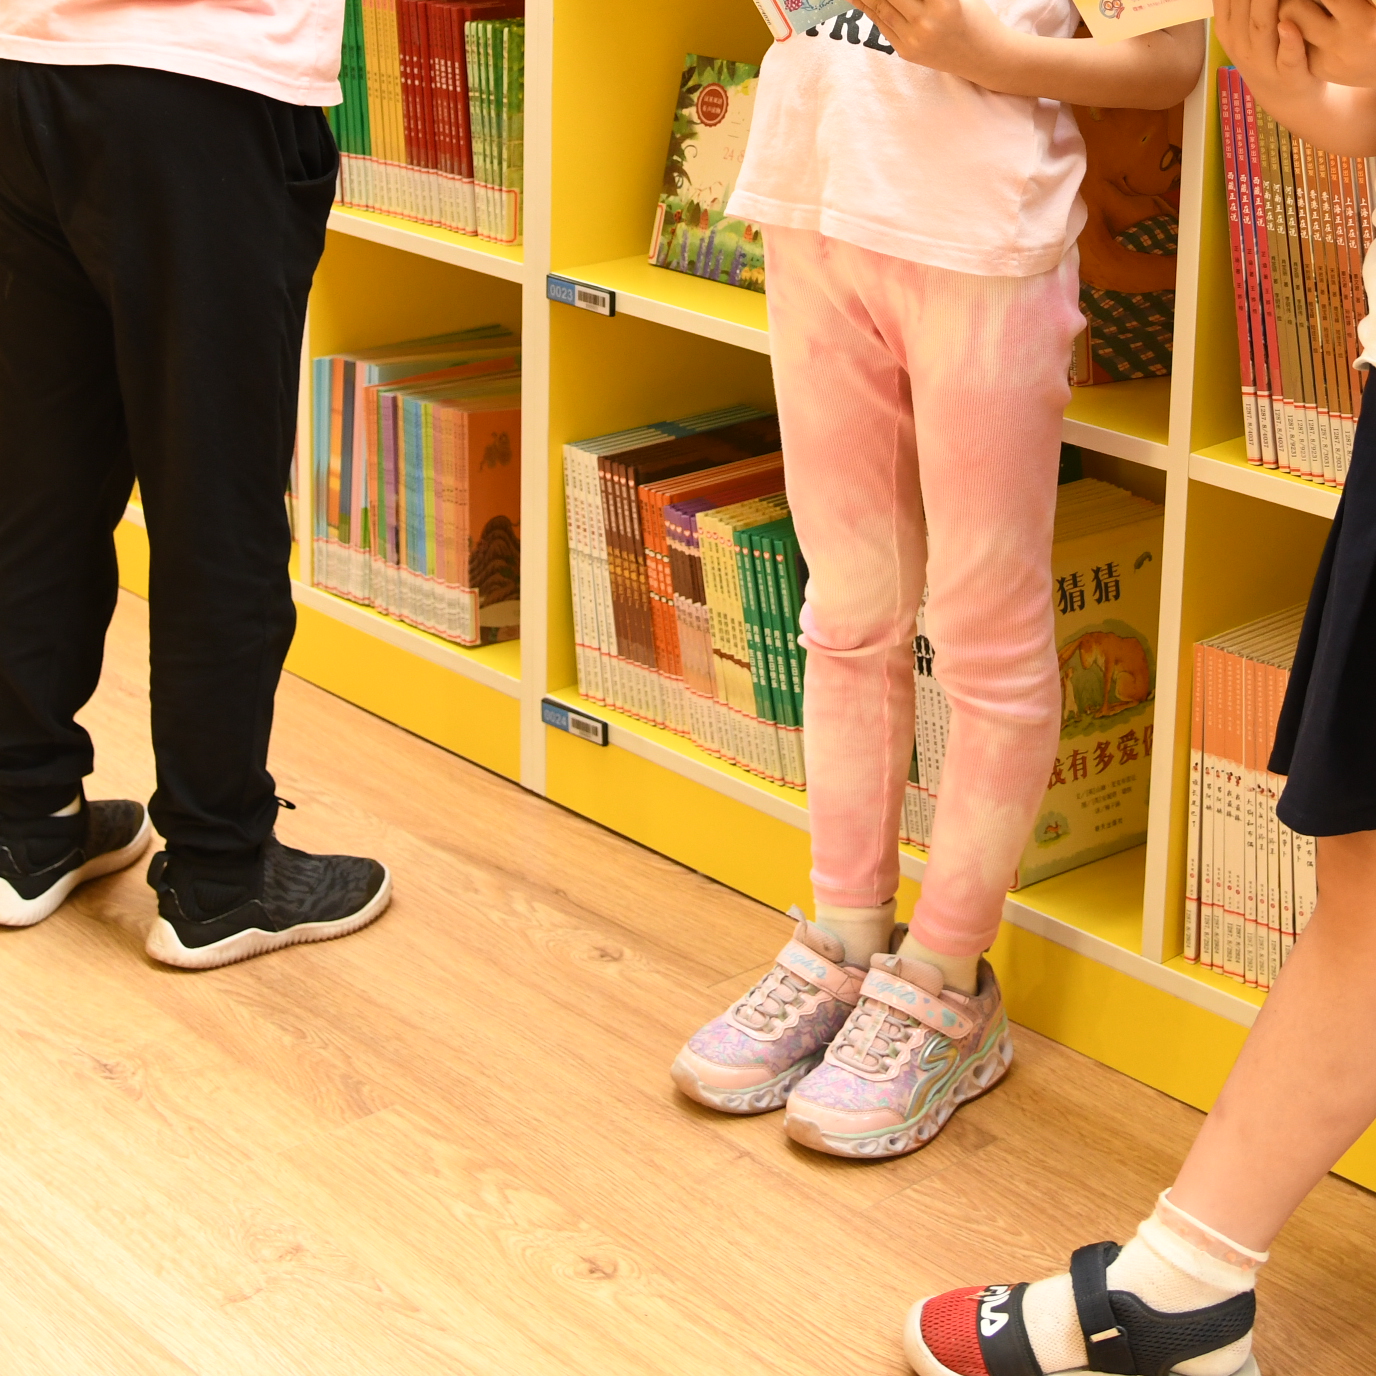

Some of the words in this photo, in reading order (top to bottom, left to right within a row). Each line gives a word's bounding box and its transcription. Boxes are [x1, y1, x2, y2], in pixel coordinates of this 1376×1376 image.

[1333, 195, 1344, 245] 上海正在说
[1345, 197, 1357, 248] 上海正在说
[550, 284, 573, 301] 0023
[1056, 562, 1122, 615] 猜猜
